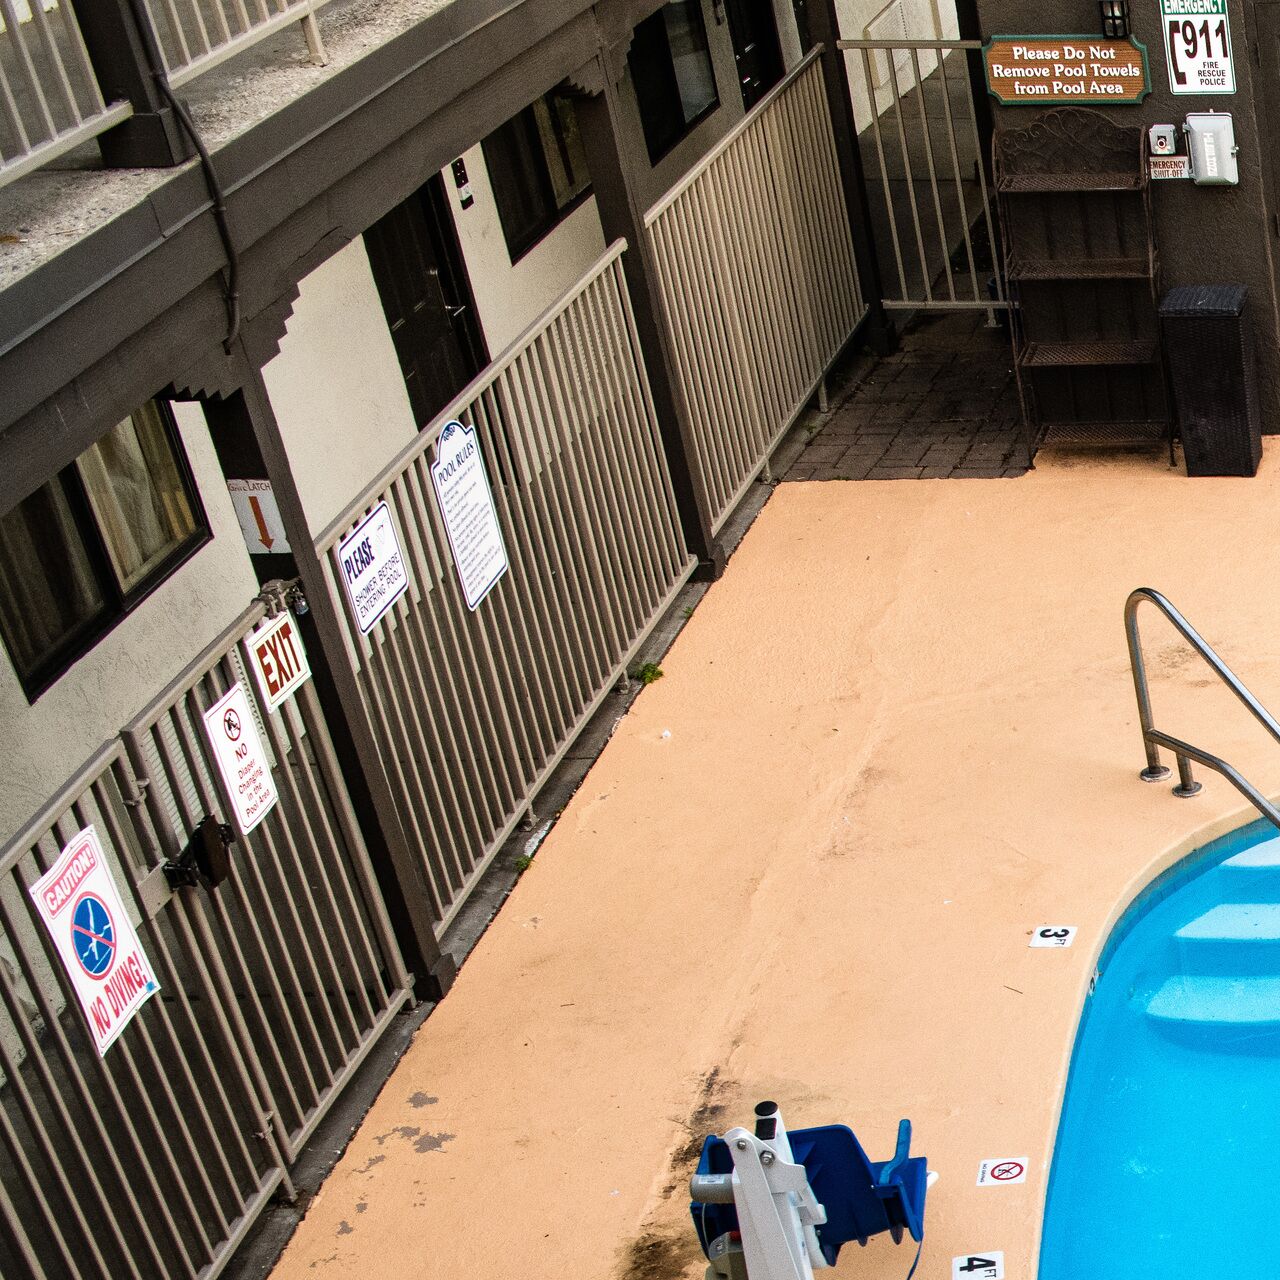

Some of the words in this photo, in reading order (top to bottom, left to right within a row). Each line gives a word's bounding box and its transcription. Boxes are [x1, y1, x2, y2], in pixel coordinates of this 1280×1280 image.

[1164, 0, 1223, 14] EMERGENCY
[1182, 19, 1228, 59] 911
[1012, 46, 1060, 60] Please
[1063, 46, 1086, 60] Do
[1089, 46, 1116, 59] Not
[992, 64, 1050, 78] Remove
[1054, 63, 1087, 77] Pool
[1090, 63, 1140, 77] Towels
[1014, 82, 1049, 95] from
[1052, 81, 1086, 94] Pool
[1089, 81, 1123, 94] Area
[1200, 78, 1226, 86] POLICE
[1150, 160, 1186, 169] EMERGENCY
[1153, 169, 1184, 178] SHUT-OFF
[438, 460, 456, 486] POOL
[456, 440, 474, 467] RULES
[248, 482, 271, 492] LATCH
[344, 536, 375, 584] PLEASE
[356, 576, 377, 607] SHOWER
[378, 552, 399, 581] BEFORE
[360, 583, 386, 618] ENTERING
[386, 569, 401, 588] POOL
[256, 621, 301, 698] EXIT
[235, 743, 247, 762] NO
[238, 758, 256, 779] Diaper
[239, 766, 264, 794] Changing
[247, 792, 254, 801] in
[254, 782, 262, 795] the
[246, 800, 259, 818] Pool
[259, 788, 270, 803] Area
[46, 848, 96, 912] CAUTION!
[1039, 928, 1070, 939] 3
[90, 996, 111, 1039] NO
[103, 951, 148, 1020] DIVING!
[959, 1256, 997, 1273] 4
[984, 1268, 997, 1278] FT
